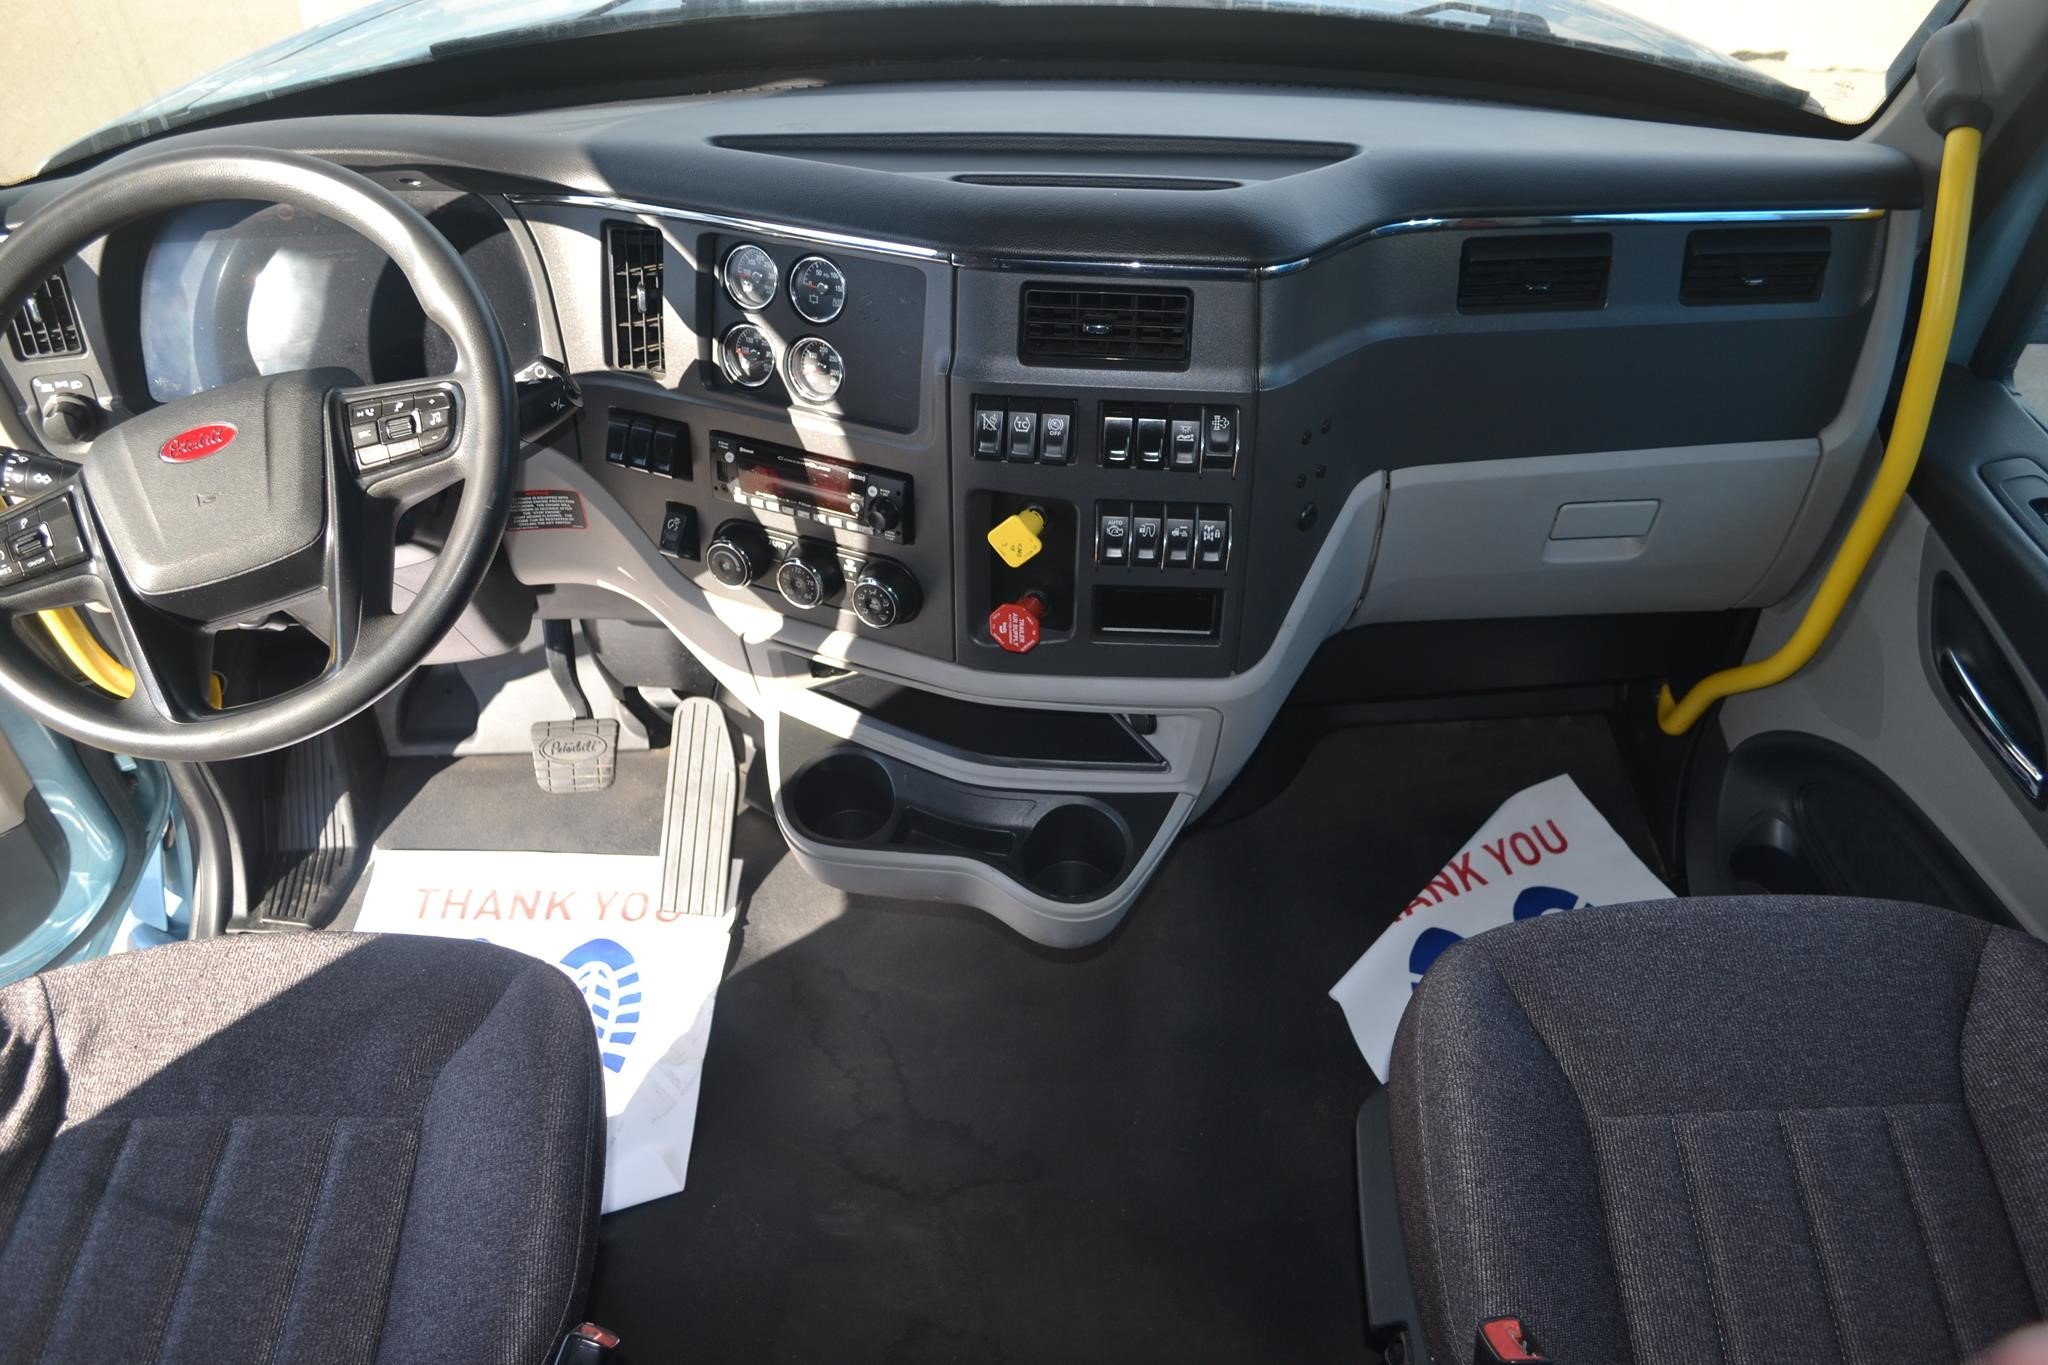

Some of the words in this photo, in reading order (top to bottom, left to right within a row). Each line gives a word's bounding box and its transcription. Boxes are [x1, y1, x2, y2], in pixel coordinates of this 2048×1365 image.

[1017, 420, 1028, 429] TC
[1481, 818, 1569, 877] YOU
[416, 888, 577, 921] THANK
